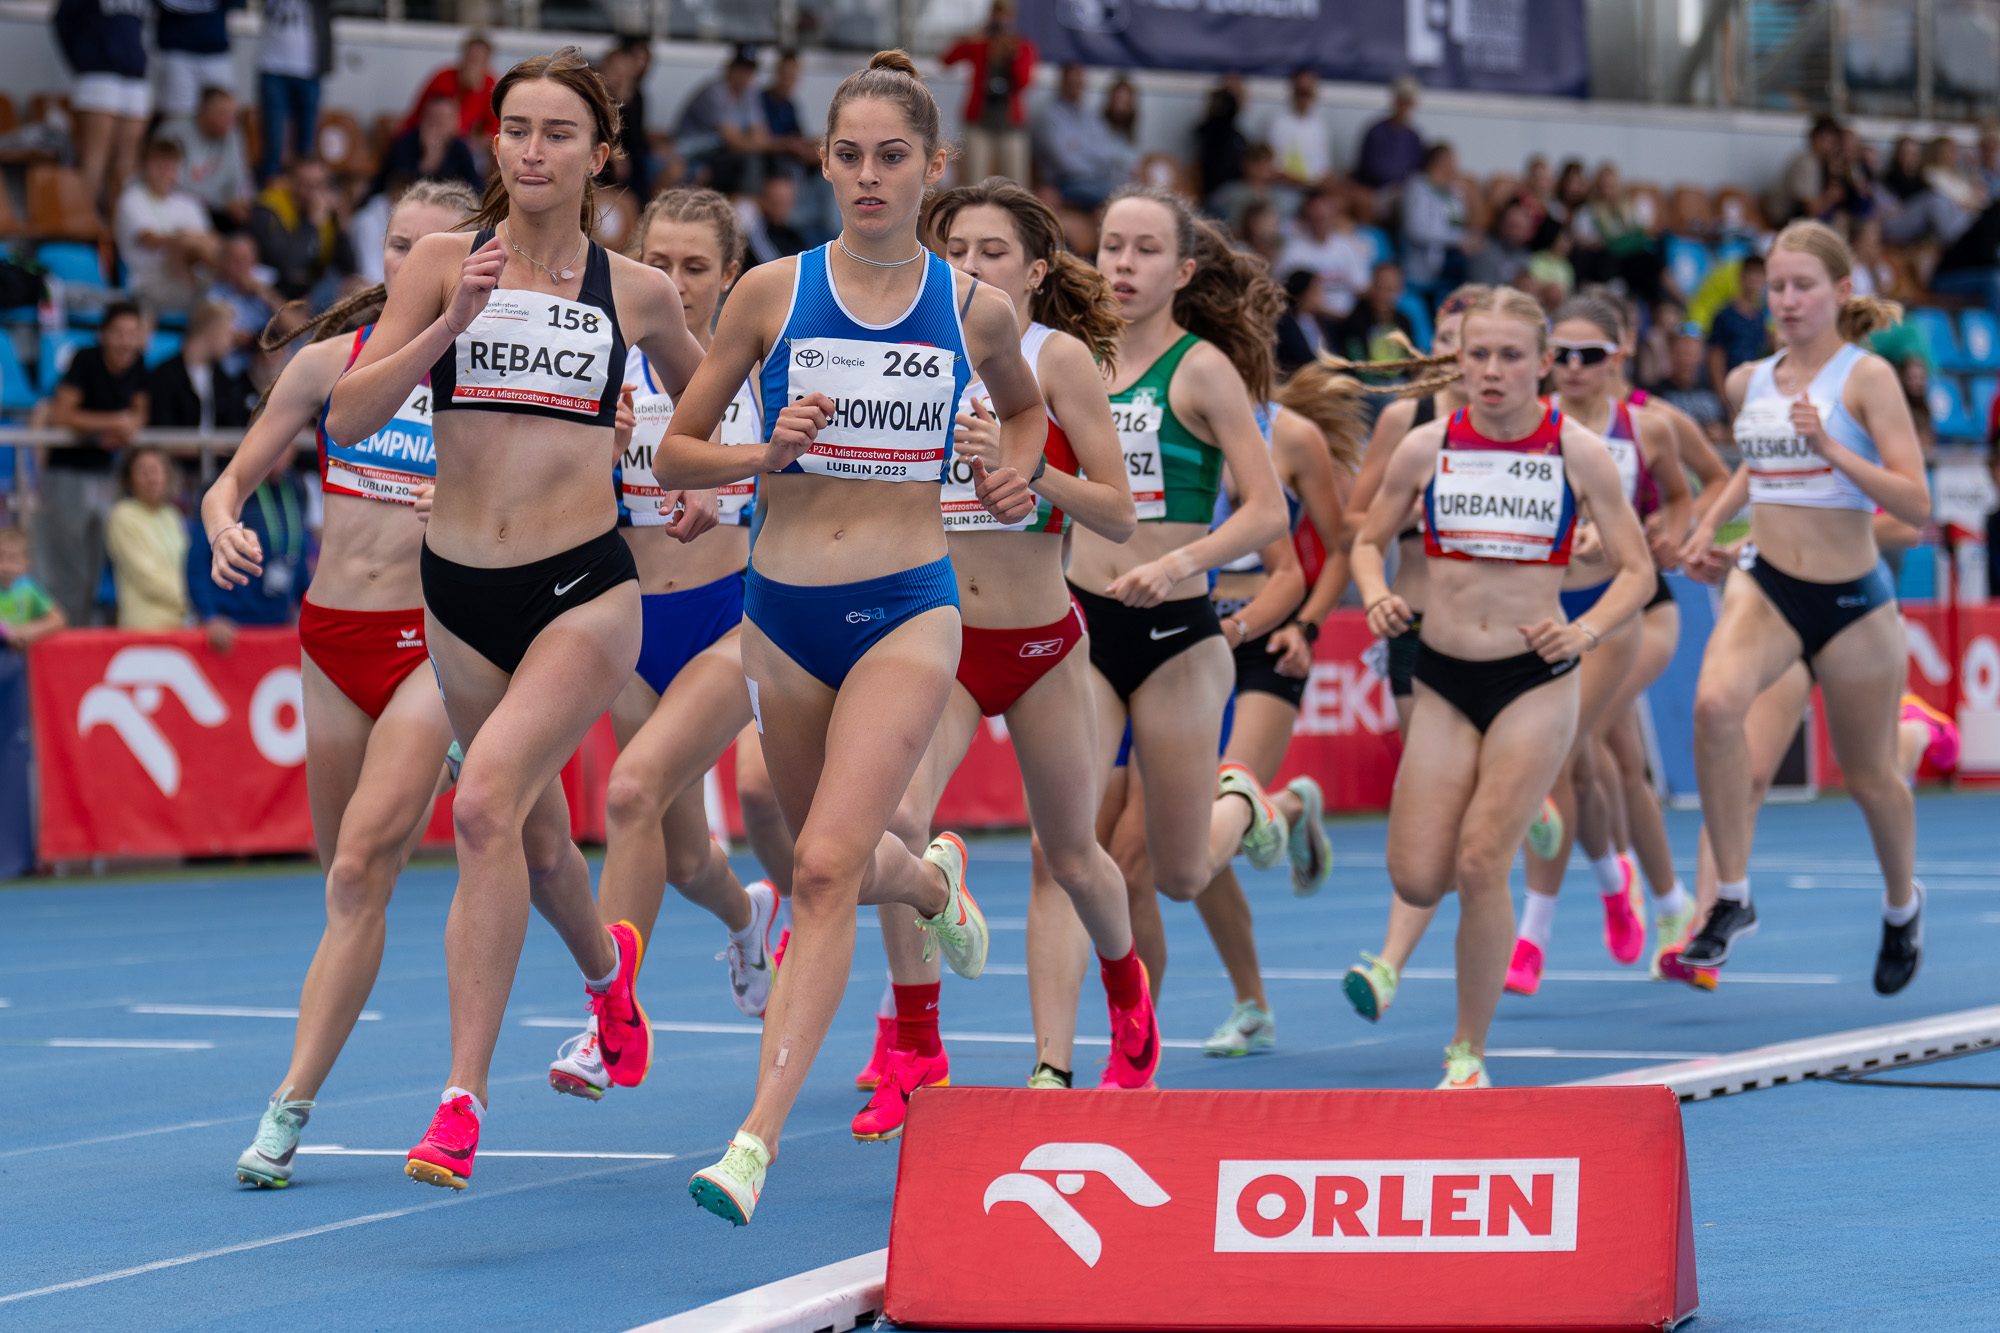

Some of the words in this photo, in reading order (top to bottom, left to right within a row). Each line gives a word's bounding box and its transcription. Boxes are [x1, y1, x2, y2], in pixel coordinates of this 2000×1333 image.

[504, 308, 530, 316] Turystyki
[547, 304, 599, 334] 158
[470, 341, 596, 382] RĘBACZ
[831, 356, 866, 368] Okęcie
[882, 350, 940, 378] 266
[476, 389, 495, 398] PZLA
[496, 390, 549, 403] Mistrzostwa
[550, 396, 573, 407] Polski
[813, 445, 833, 456] PZLA
[834, 448, 891, 460] Mistrzostwa
[893, 452, 919, 460] Polski
[920, 451, 936, 460] U20
[362, 468, 410, 482] Mistrzostwa
[826, 461, 872, 475] LUBLIN
[874, 465, 907, 476] 2023
[1508, 461, 1552, 481] 498
[357, 479, 393, 494] LUBLIN
[640, 488, 659, 496] PZLA
[716, 485, 733, 494] olski
[734, 485, 748, 494] U20
[1440, 495, 1555, 521] URBANIAK
[396, 640, 423, 648] erima
[1236, 1173, 1554, 1239] ORLEN
